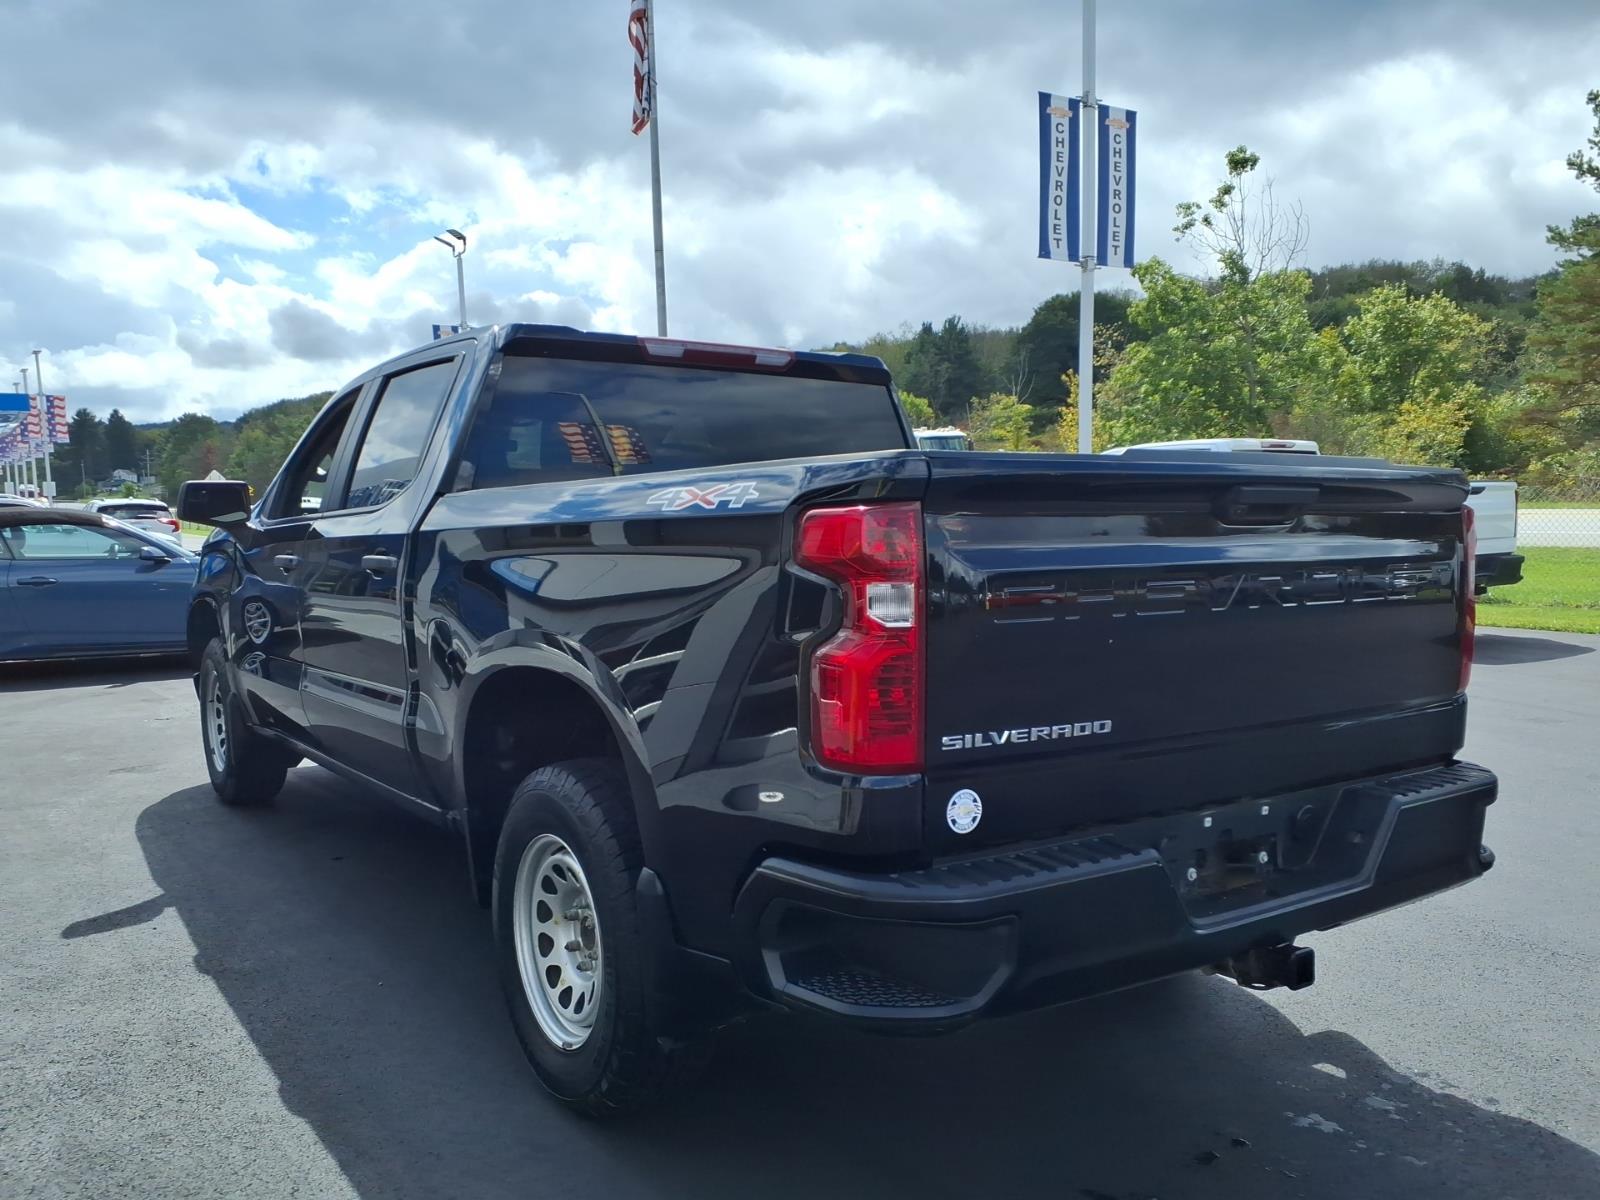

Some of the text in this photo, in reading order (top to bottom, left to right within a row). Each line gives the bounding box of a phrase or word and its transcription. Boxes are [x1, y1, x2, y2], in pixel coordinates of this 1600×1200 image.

[1053, 122, 1065, 249] CHEVROLET
[1111, 133, 1122, 256] CHEVROLET
[941, 719, 1113, 751] SILVERADO
